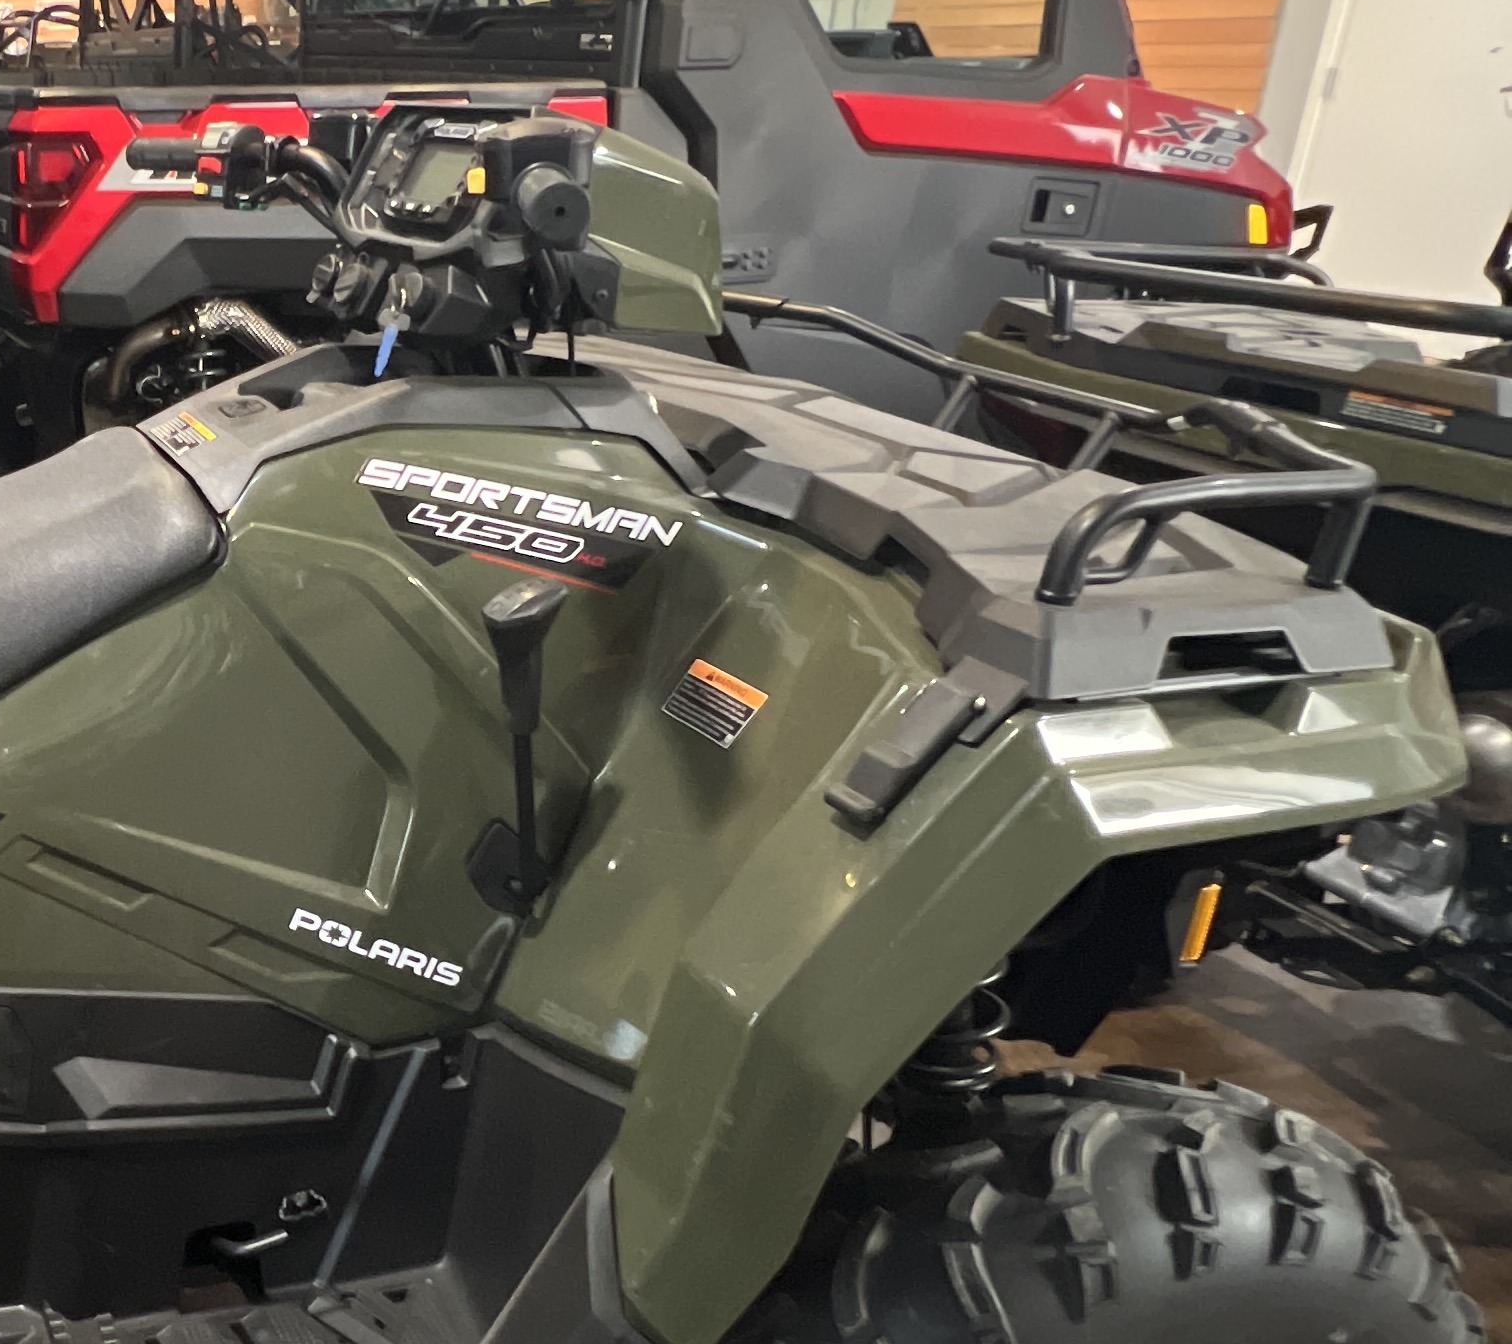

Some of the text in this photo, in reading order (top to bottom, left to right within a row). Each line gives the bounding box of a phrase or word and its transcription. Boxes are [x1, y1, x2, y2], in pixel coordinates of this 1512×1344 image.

[1140, 115, 1250, 145] XP
[1159, 143, 1235, 166] 1000
[358, 458, 683, 546] SPORTSMAN
[407, 502, 585, 563] 450
[288, 908, 464, 987] POLARIS
